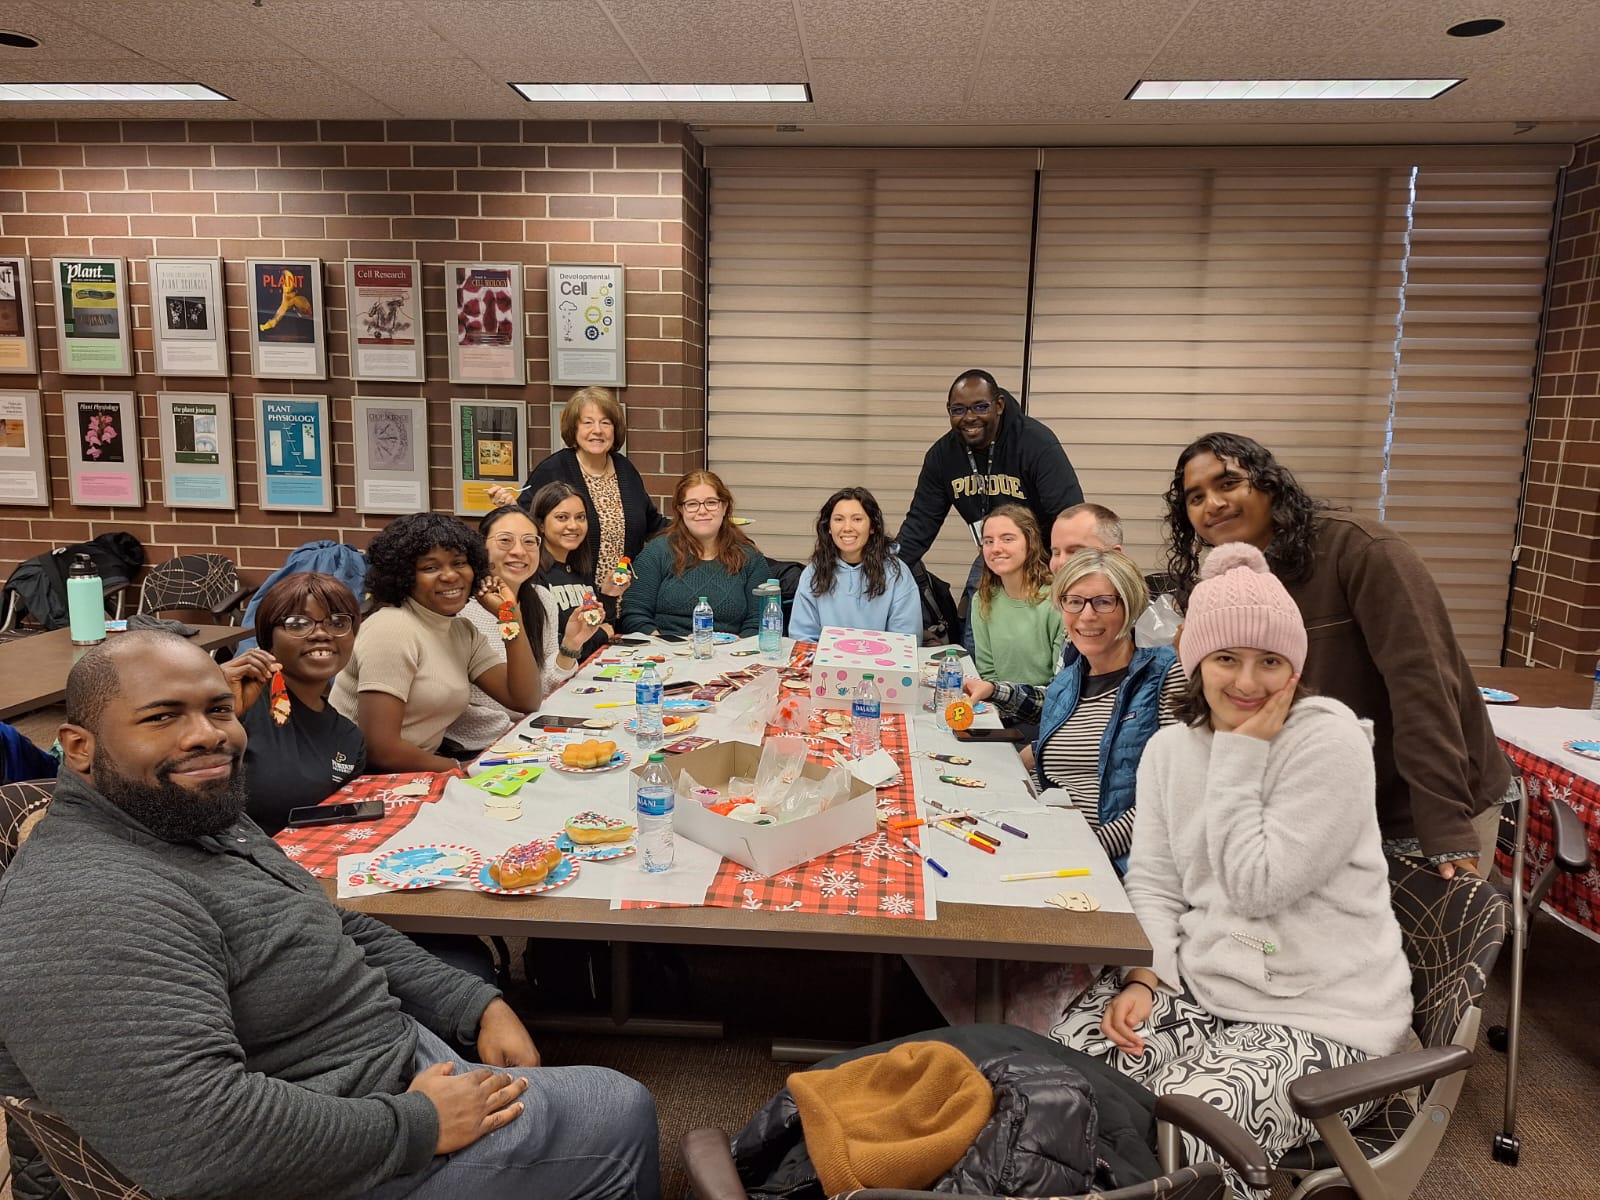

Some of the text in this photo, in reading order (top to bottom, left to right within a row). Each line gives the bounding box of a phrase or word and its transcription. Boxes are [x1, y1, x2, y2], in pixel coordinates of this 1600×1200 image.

[357, 270, 406, 279] Cell Research
[559, 273, 610, 281] Developmental
[263, 274, 304, 288] PLANT
[560, 281, 588, 296] Cell
[181, 406, 195, 414] plant
[267, 404, 292, 413] PLANT
[268, 414, 316, 422] PHYSIOLOGY
